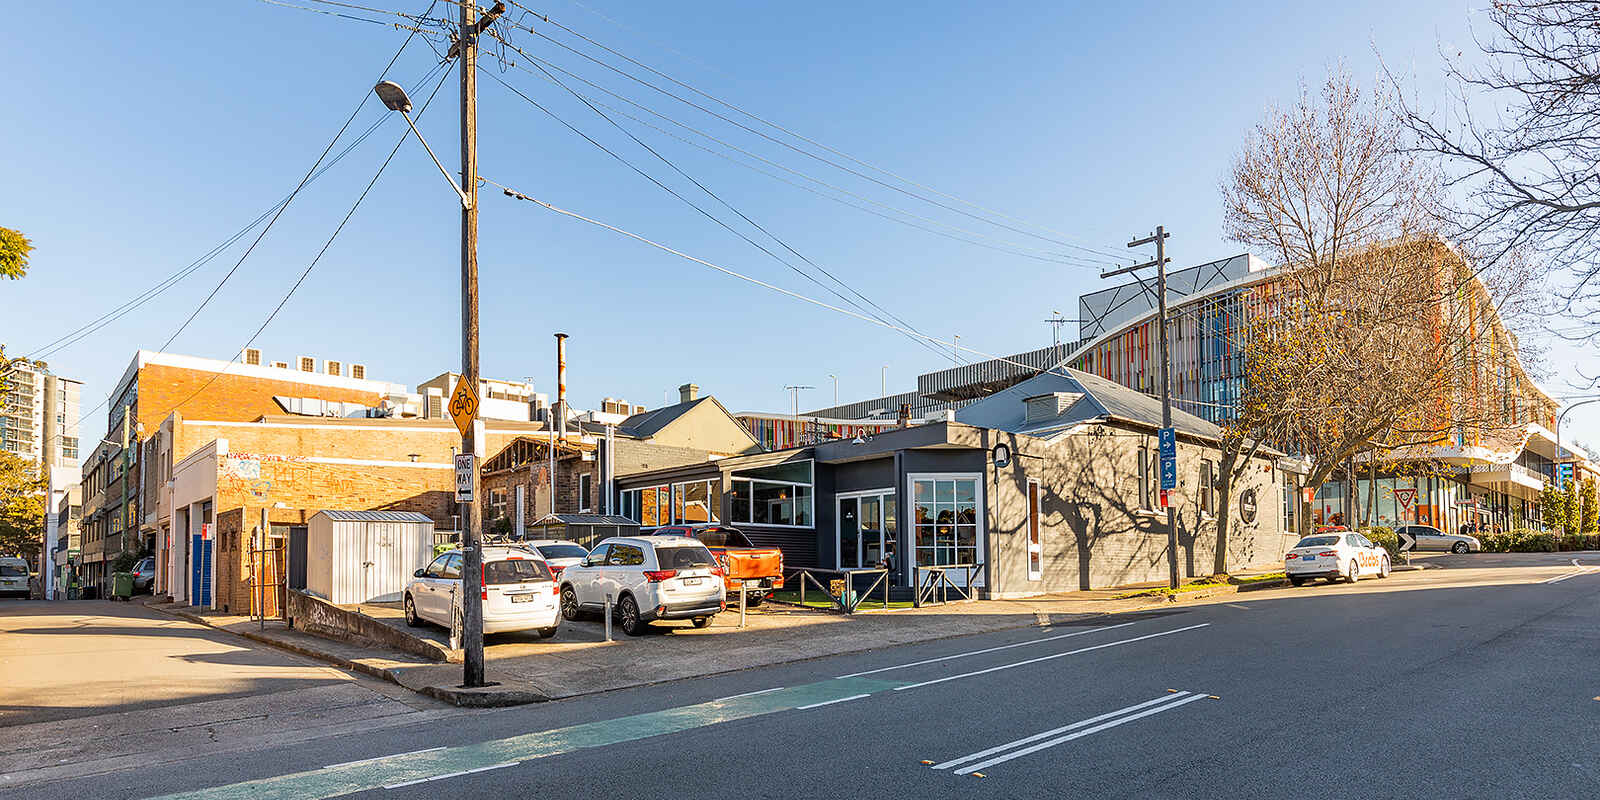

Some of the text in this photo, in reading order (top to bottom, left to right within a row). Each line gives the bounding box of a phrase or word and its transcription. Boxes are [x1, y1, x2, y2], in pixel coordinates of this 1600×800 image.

[1163, 431, 1170, 440] P
[457, 459, 471, 470] ONE
[1165, 461, 1172, 471] P
[457, 473, 471, 485] WAY
